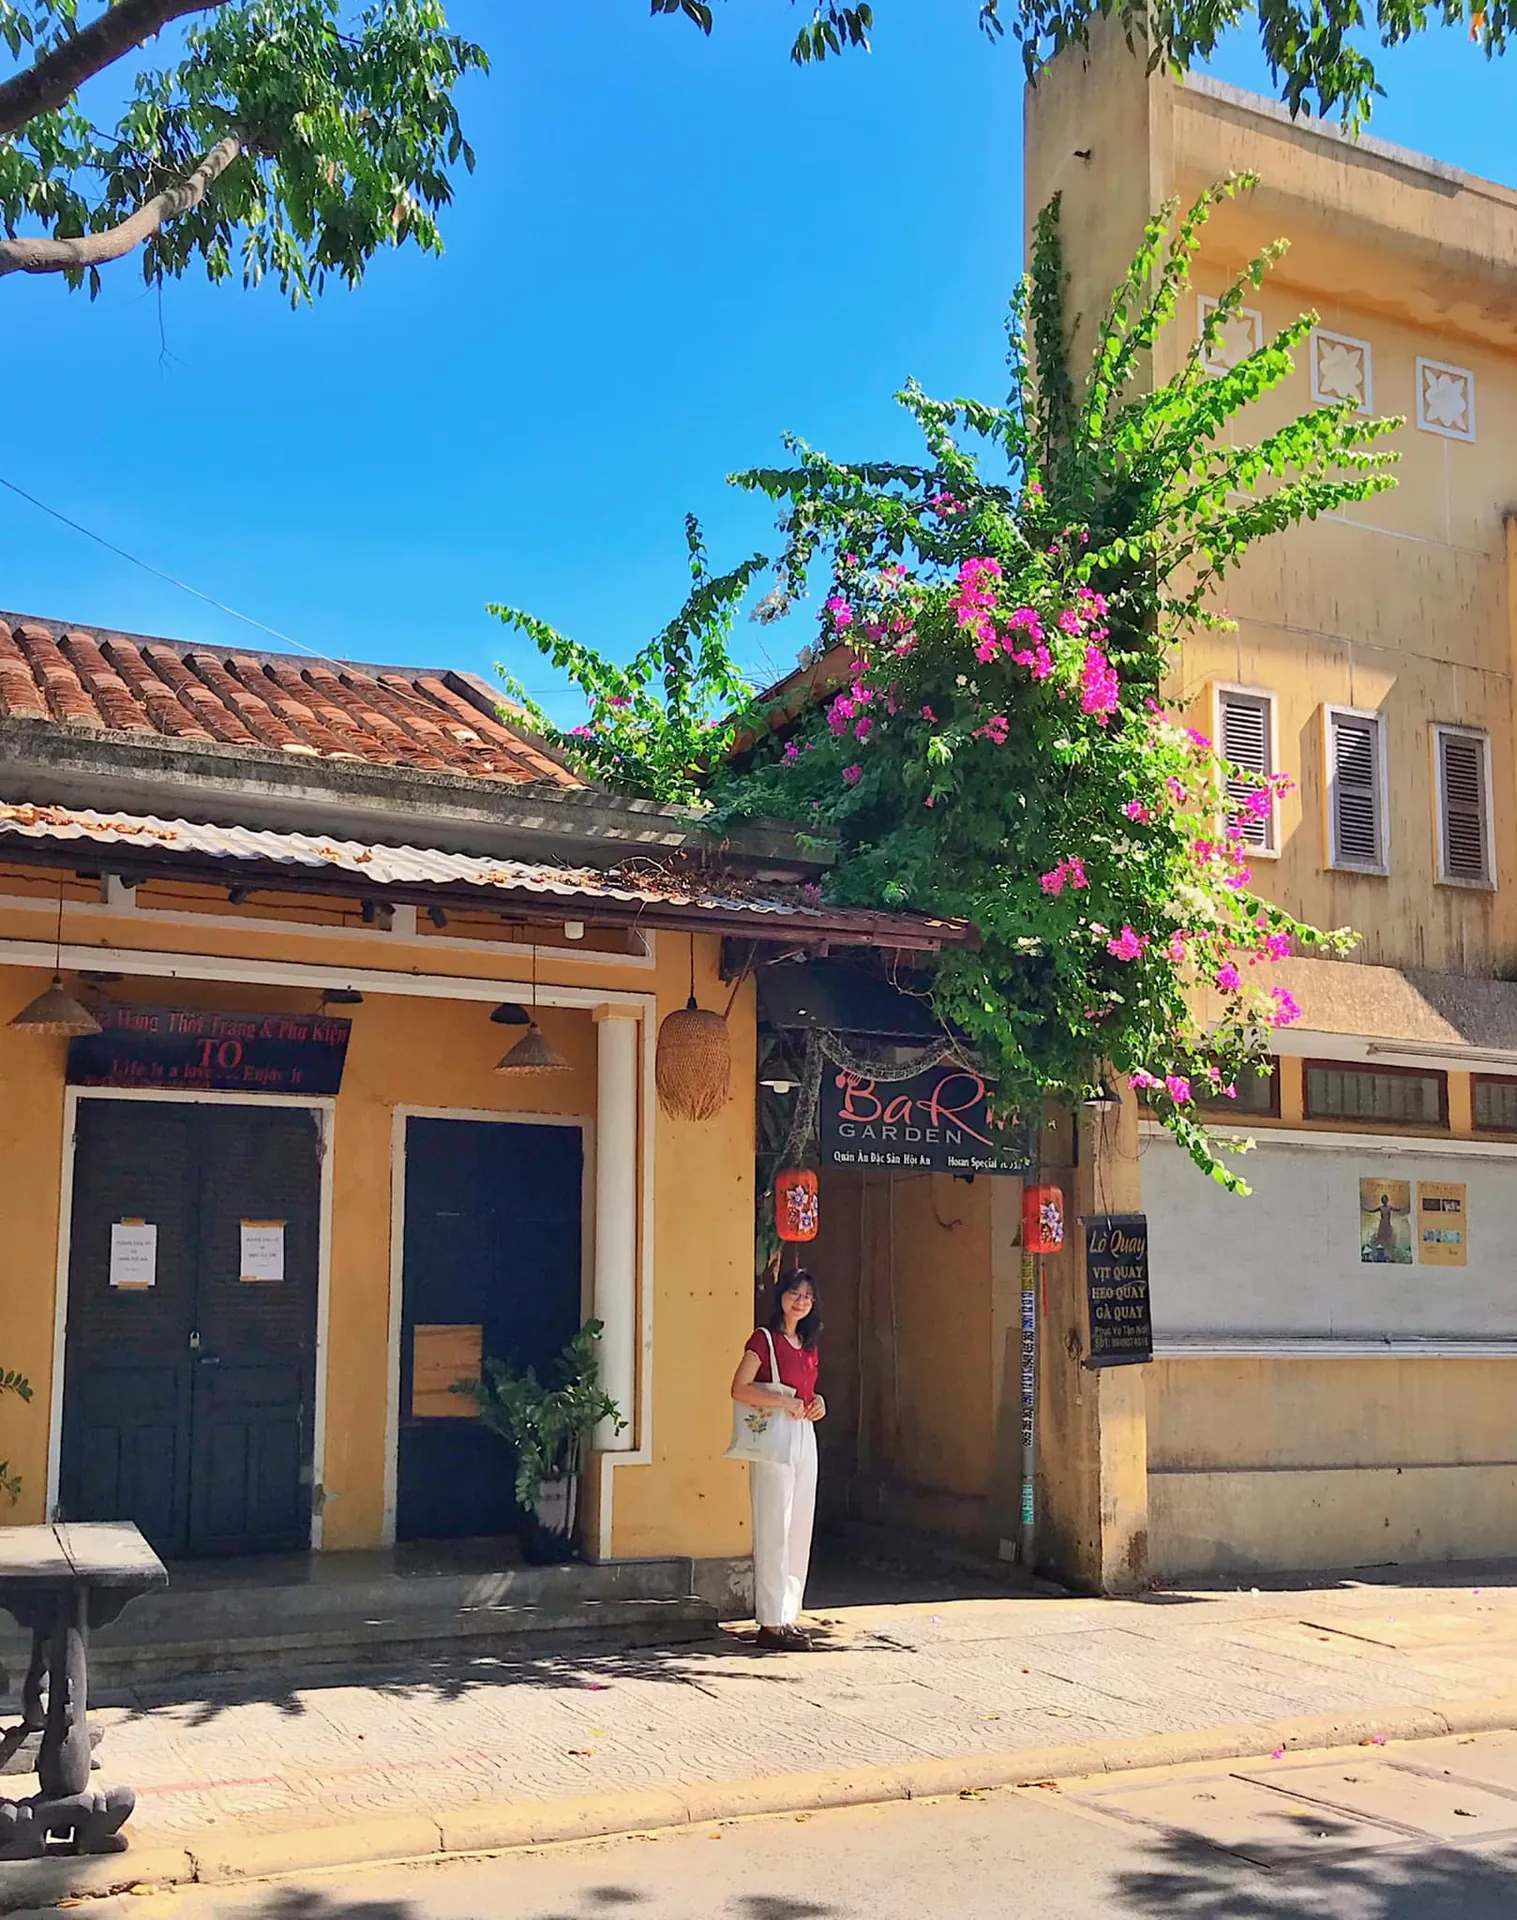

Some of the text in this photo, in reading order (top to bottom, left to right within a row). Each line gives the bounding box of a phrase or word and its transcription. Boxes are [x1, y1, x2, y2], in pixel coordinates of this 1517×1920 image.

[211, 1015, 256, 1040] Trang
[196, 1038, 243, 1069] TO
[838, 1123, 961, 1144] GARDEN
[919, 1154, 931, 1165] An
[971, 1156, 997, 1170] Special
[1089, 1229, 1145, 1260] Lò Quay
[1093, 1266, 1143, 1282] VỊT QUAY
[1092, 1286, 1145, 1300] HEO QUAY
[1096, 1303, 1143, 1321] GÀ QUAY
